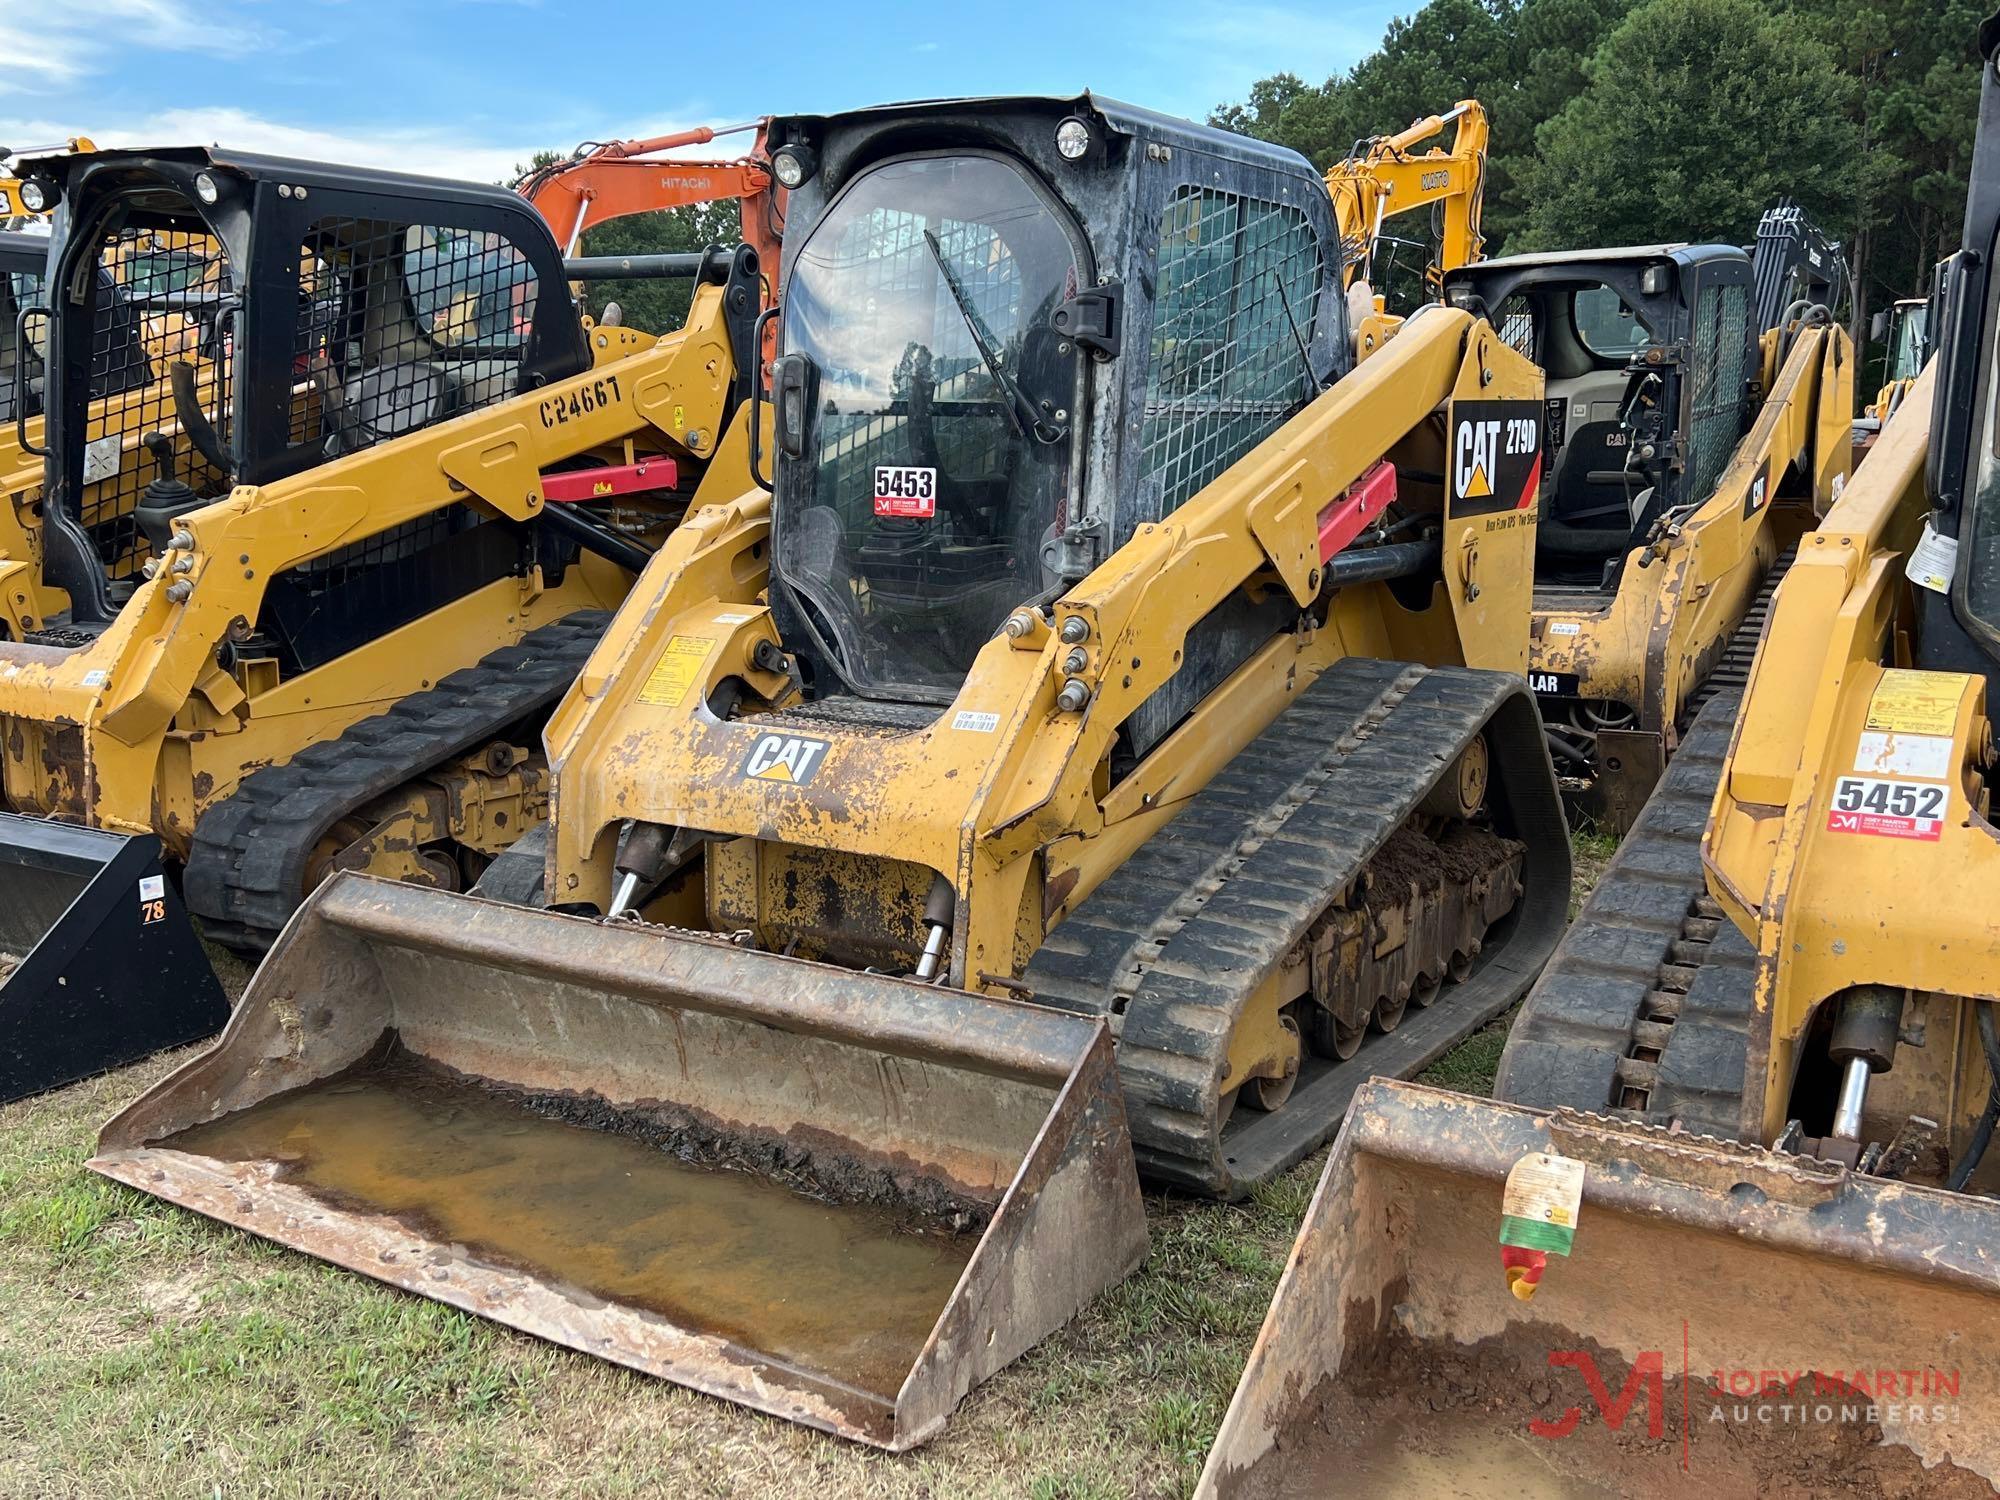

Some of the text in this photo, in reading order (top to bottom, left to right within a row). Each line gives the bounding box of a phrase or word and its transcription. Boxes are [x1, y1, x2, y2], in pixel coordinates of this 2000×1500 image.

[661, 177, 711, 189] HITACHI
[1422, 170, 1449, 191] KATO
[540, 376, 621, 428] C24667
[1455, 419, 1537, 499] CAT 279D
[877, 470, 932, 498] 5453
[746, 735, 824, 783] CAT
[1838, 780, 1944, 819] 5452
[142, 901, 165, 922] 78
